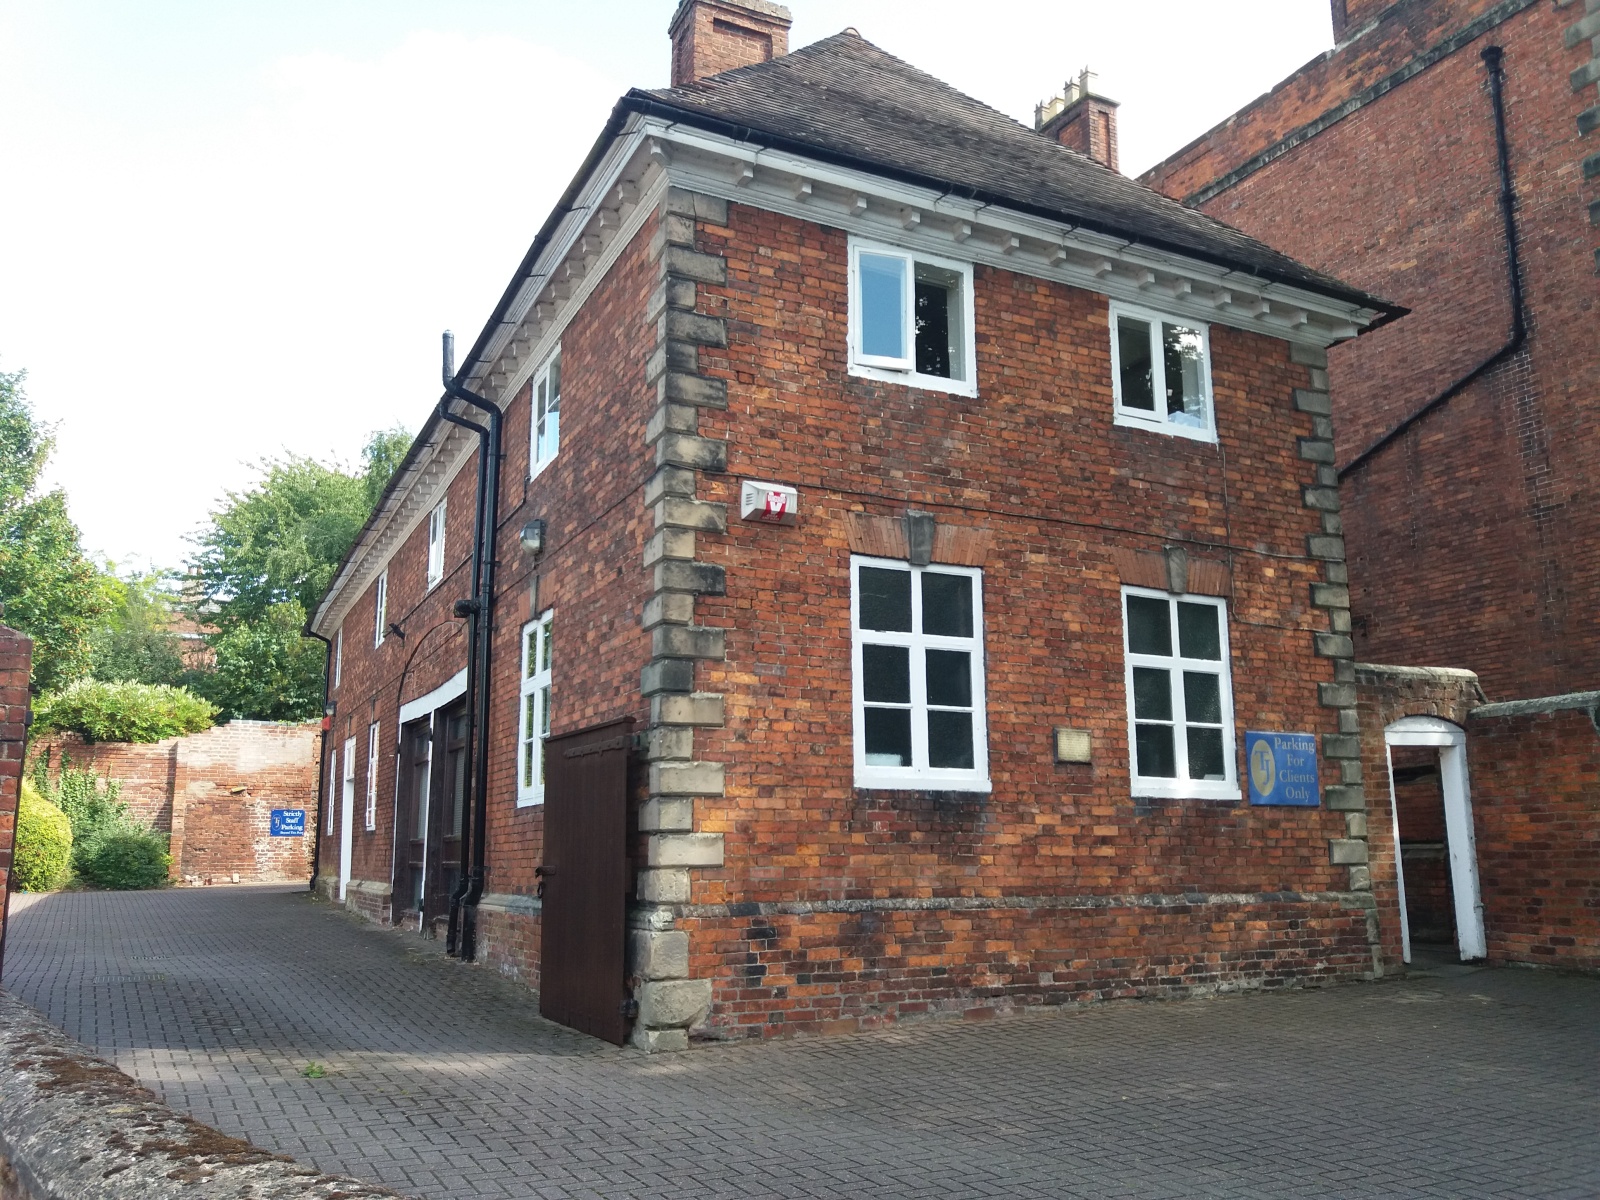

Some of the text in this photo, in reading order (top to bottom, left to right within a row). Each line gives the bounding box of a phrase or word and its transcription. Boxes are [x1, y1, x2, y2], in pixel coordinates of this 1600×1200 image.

[1274, 737, 1315, 754] Parking
[1287, 754, 1304, 767] For
[1279, 769, 1315, 783] Clients
[1285, 786, 1311, 802] Only
